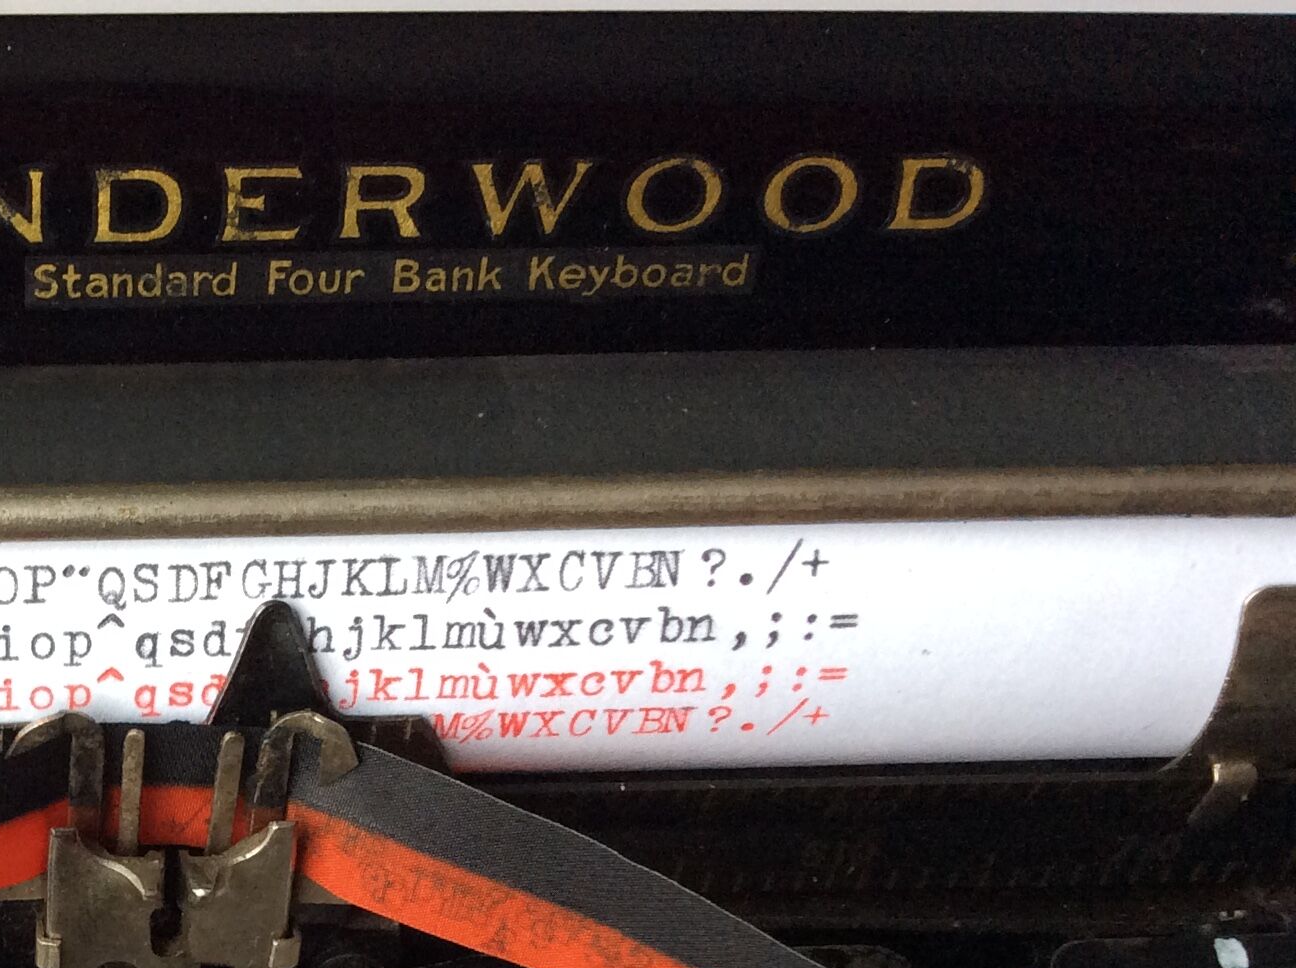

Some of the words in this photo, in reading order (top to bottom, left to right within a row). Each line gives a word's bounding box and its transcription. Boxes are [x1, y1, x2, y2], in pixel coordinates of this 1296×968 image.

[32, 262, 238, 300] Standard
[267, 260, 365, 295] Four
[392, 256, 502, 293] Bank
[527, 253, 750, 297] Keyboard
